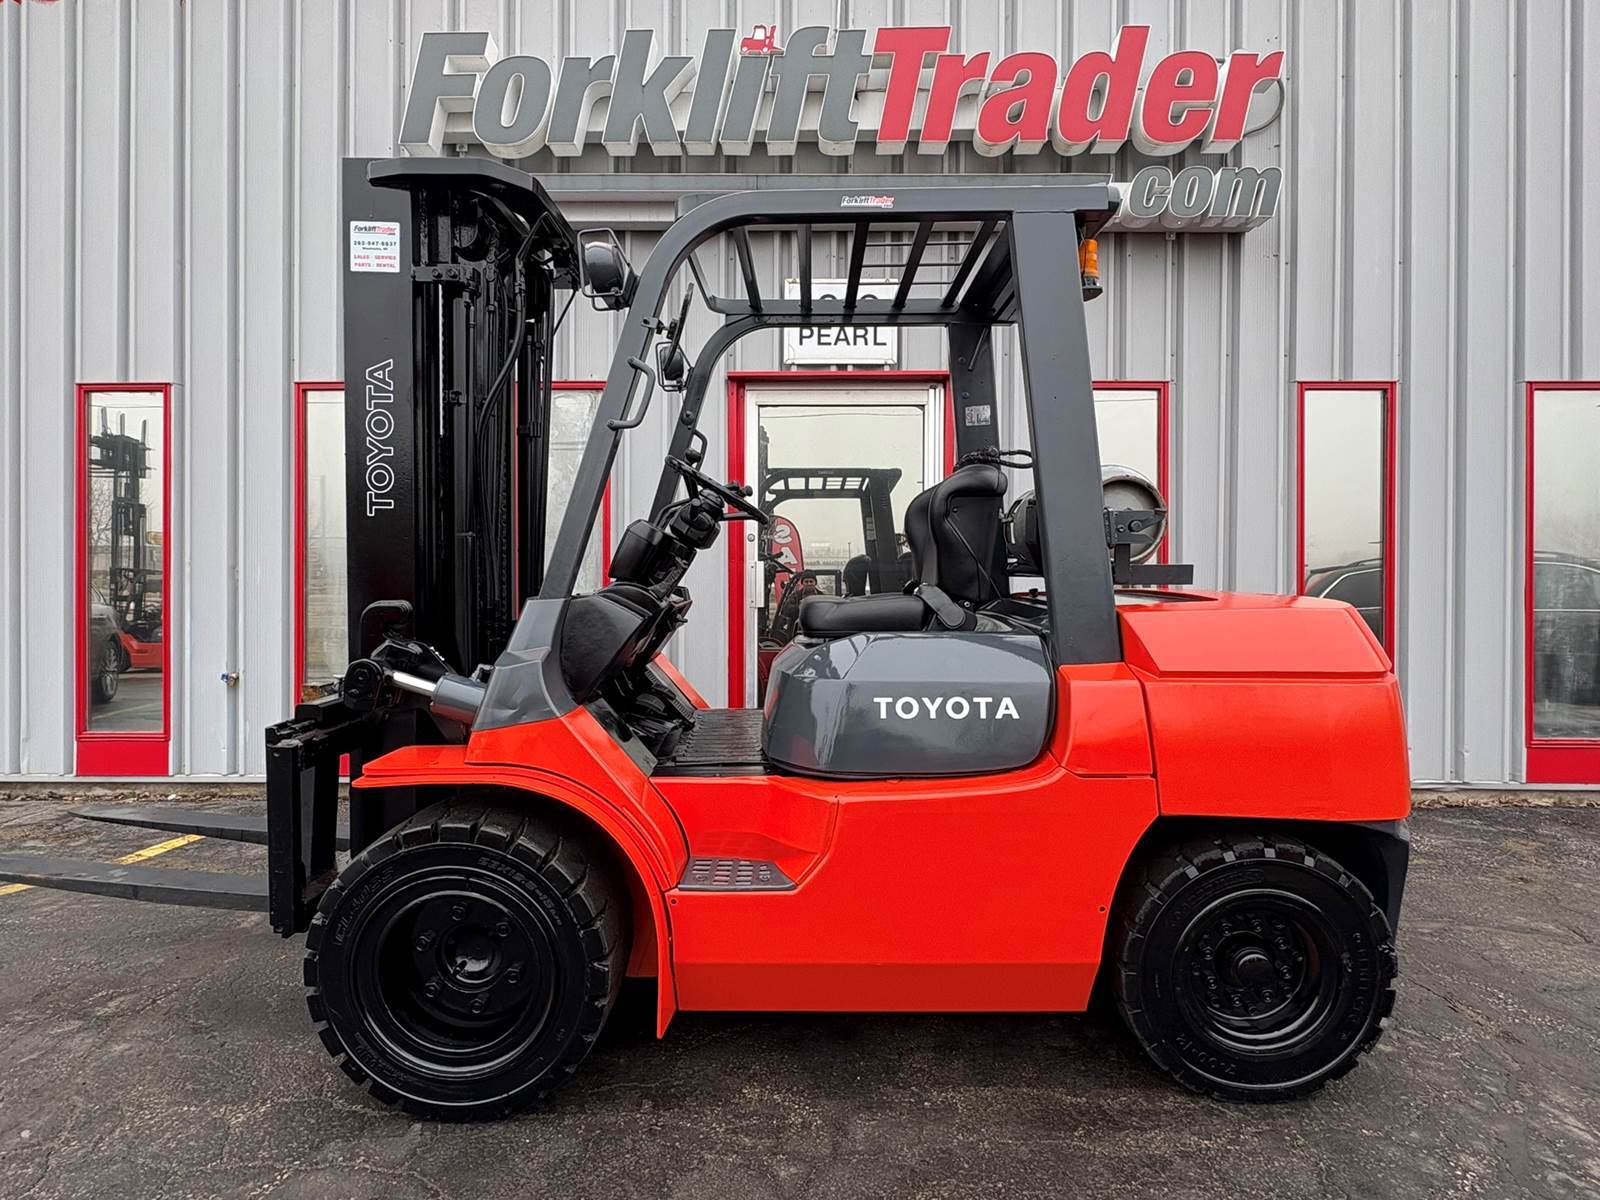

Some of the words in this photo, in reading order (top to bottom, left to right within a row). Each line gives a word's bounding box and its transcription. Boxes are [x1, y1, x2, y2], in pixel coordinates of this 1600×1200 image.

[398, 25, 1284, 147] ForkliftTrader
[842, 196, 894, 205] ForkliftTrader
[1119, 165, 1283, 218] com
[799, 326, 887, 346] PEARL
[366, 358, 395, 517] TOYOTA
[873, 696, 1020, 719] TOYOTA
